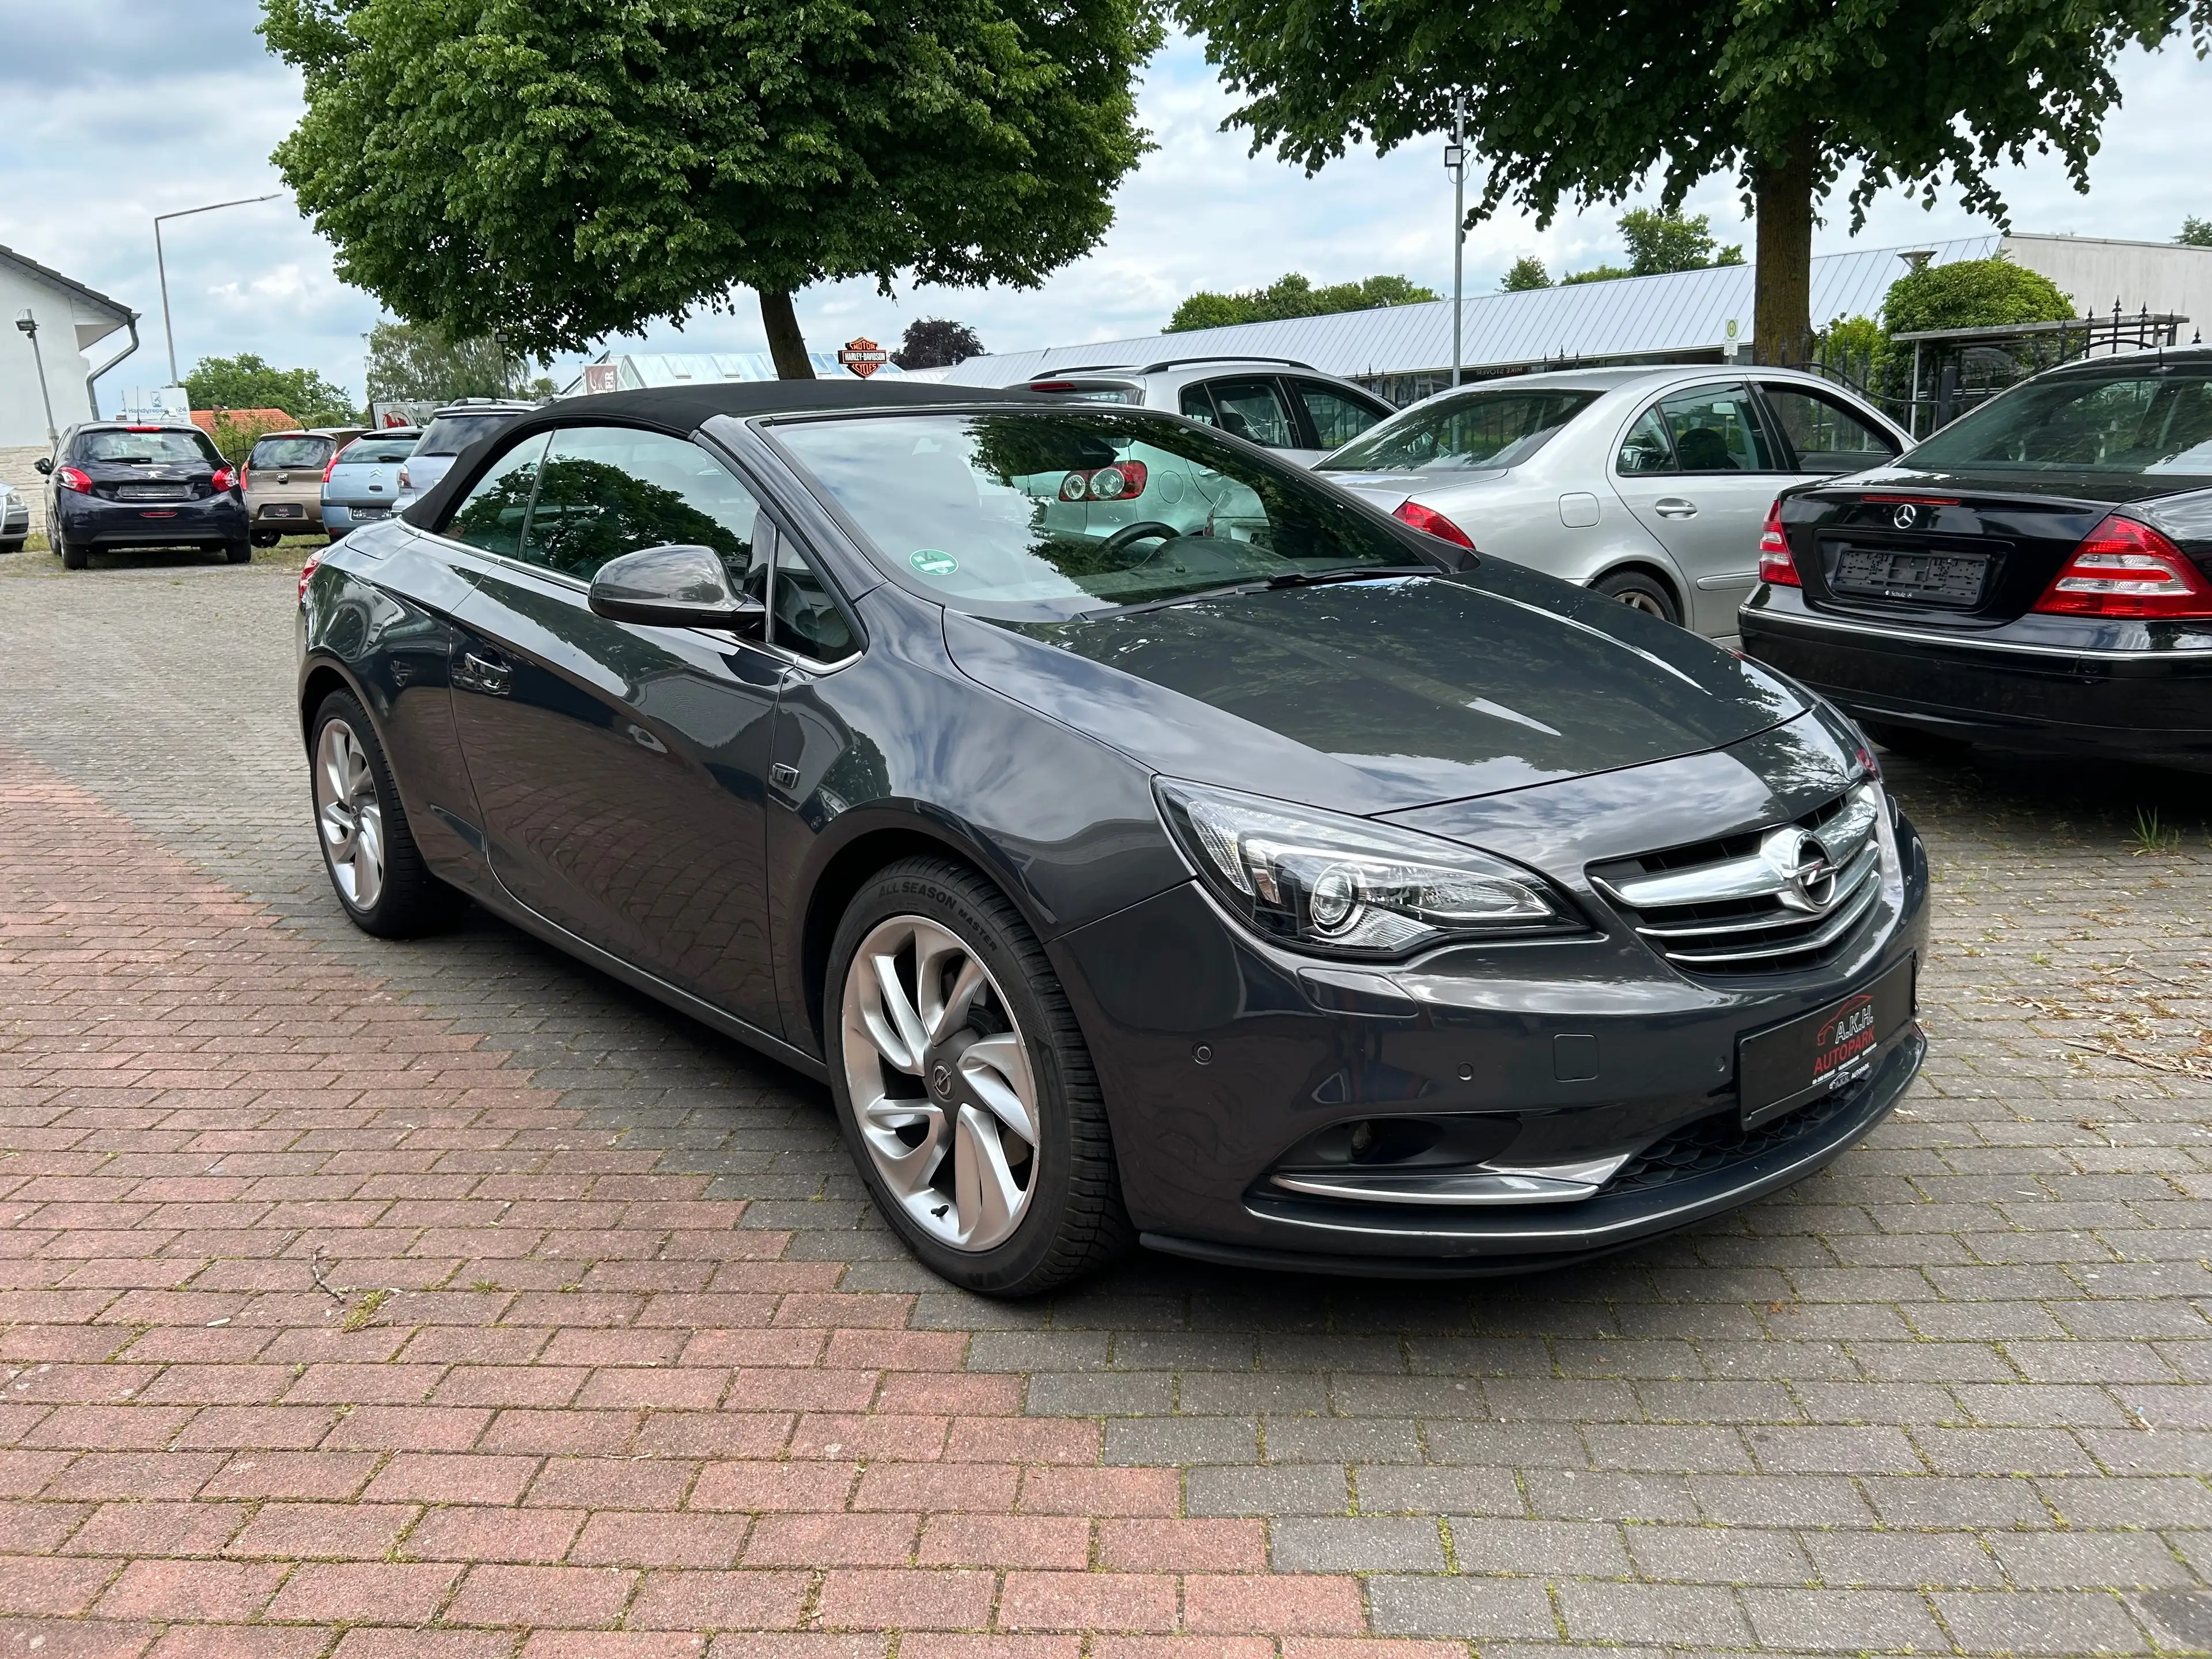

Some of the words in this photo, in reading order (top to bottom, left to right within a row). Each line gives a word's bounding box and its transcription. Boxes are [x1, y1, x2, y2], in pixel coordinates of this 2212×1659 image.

[844, 353, 885, 361] HARLEY-DAVIDSON
[854, 340, 876, 350] MOTOR
[855, 363, 877, 375] CYCLES
[878, 882, 899, 899] ALL
[902, 881, 957, 910] SEASON
[957, 908, 998, 951] MASTER
[1835, 1005, 1873, 1044] A.K.H.
[1813, 1025, 1876, 1075] AUTOPARK
